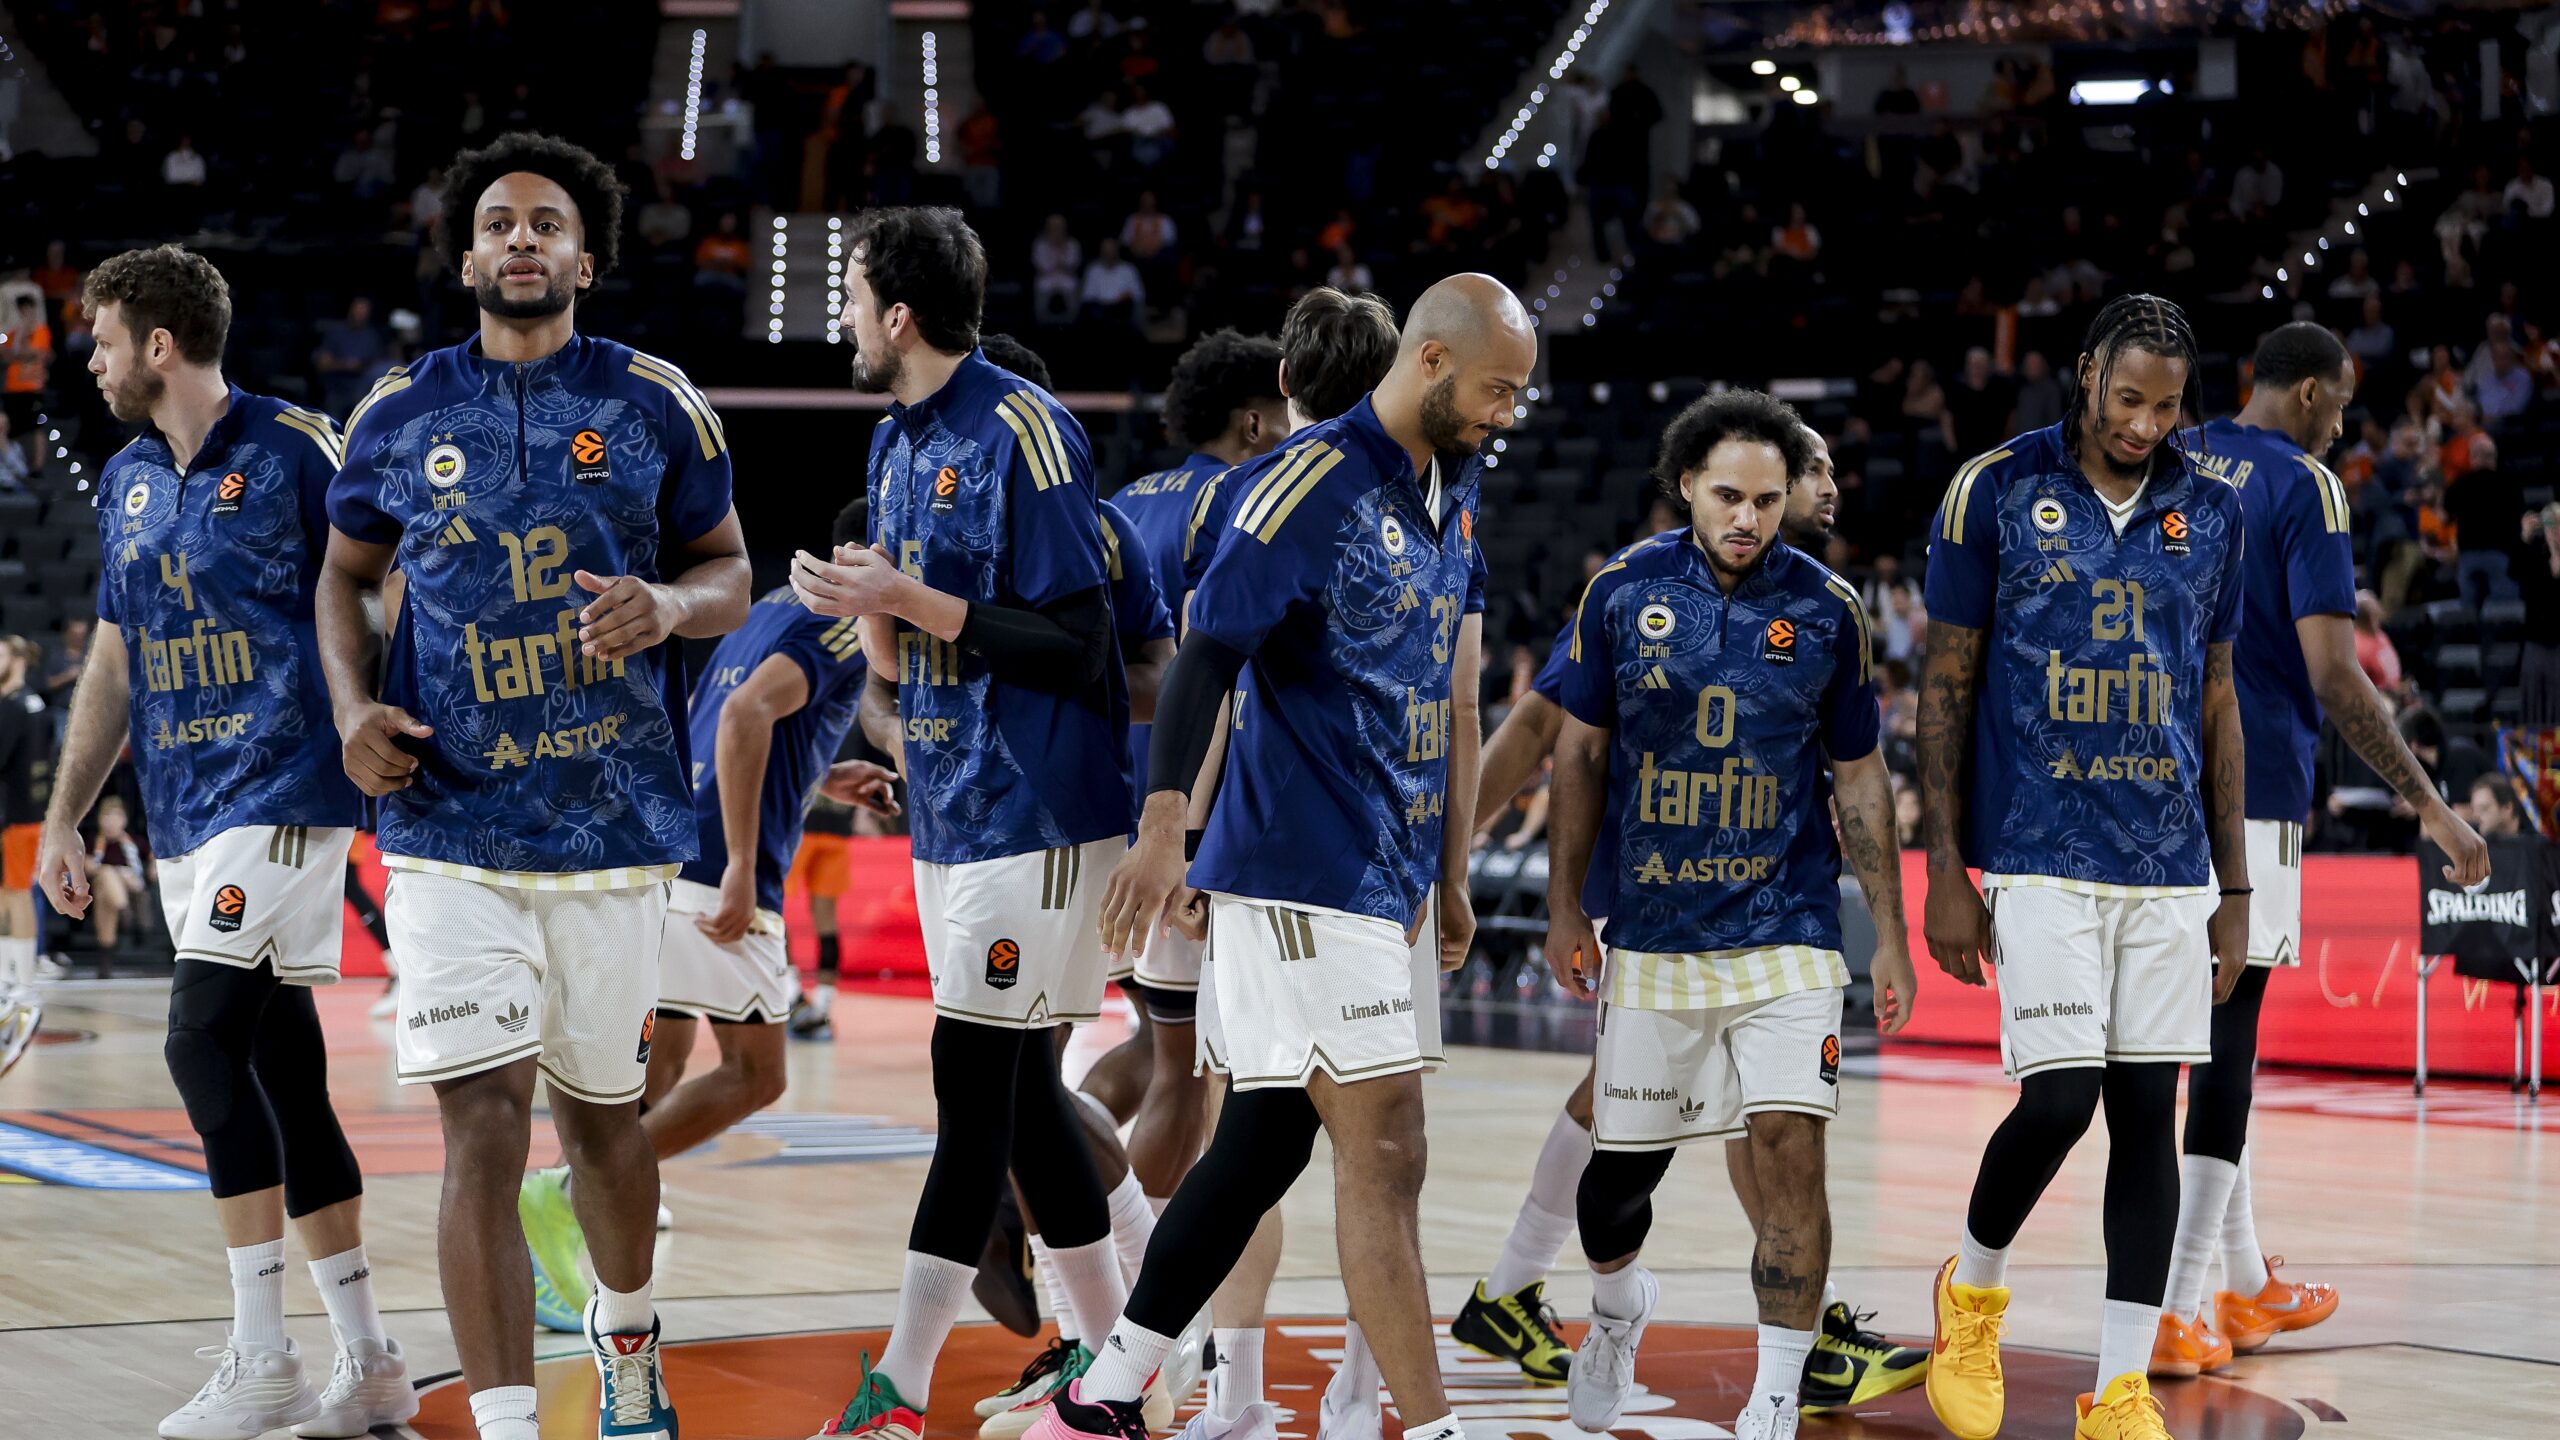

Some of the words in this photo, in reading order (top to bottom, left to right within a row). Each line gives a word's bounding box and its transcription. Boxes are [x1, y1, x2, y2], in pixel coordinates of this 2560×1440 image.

[576, 469, 610, 481] ETIHAD
[1127, 470, 1194, 496] SILVA
[432, 488, 466, 510] tarfin
[2037, 535, 2069, 552] tarfin
[498, 525, 572, 603] 12
[160, 552, 194, 611] 4
[2091, 577, 2145, 643] 21
[139, 617, 254, 692] tarfin
[1639, 641, 1671, 659] tarfin
[1764, 653, 1794, 662] ETIHAD
[2046, 649, 2172, 727] tarfin
[1695, 685, 1736, 748] 0
[1638, 751, 1778, 829] tarfin
[2427, 888, 2528, 927] SPALDING
[429, 1000, 480, 1024] Hotels
[1341, 1000, 1390, 1021] Limak
[2014, 1003, 2050, 1021] Limak
[2052, 1001, 2094, 1016] Hotels
[1604, 1082, 1638, 1100] Limak
[1642, 1086, 1679, 1101] Hotels
